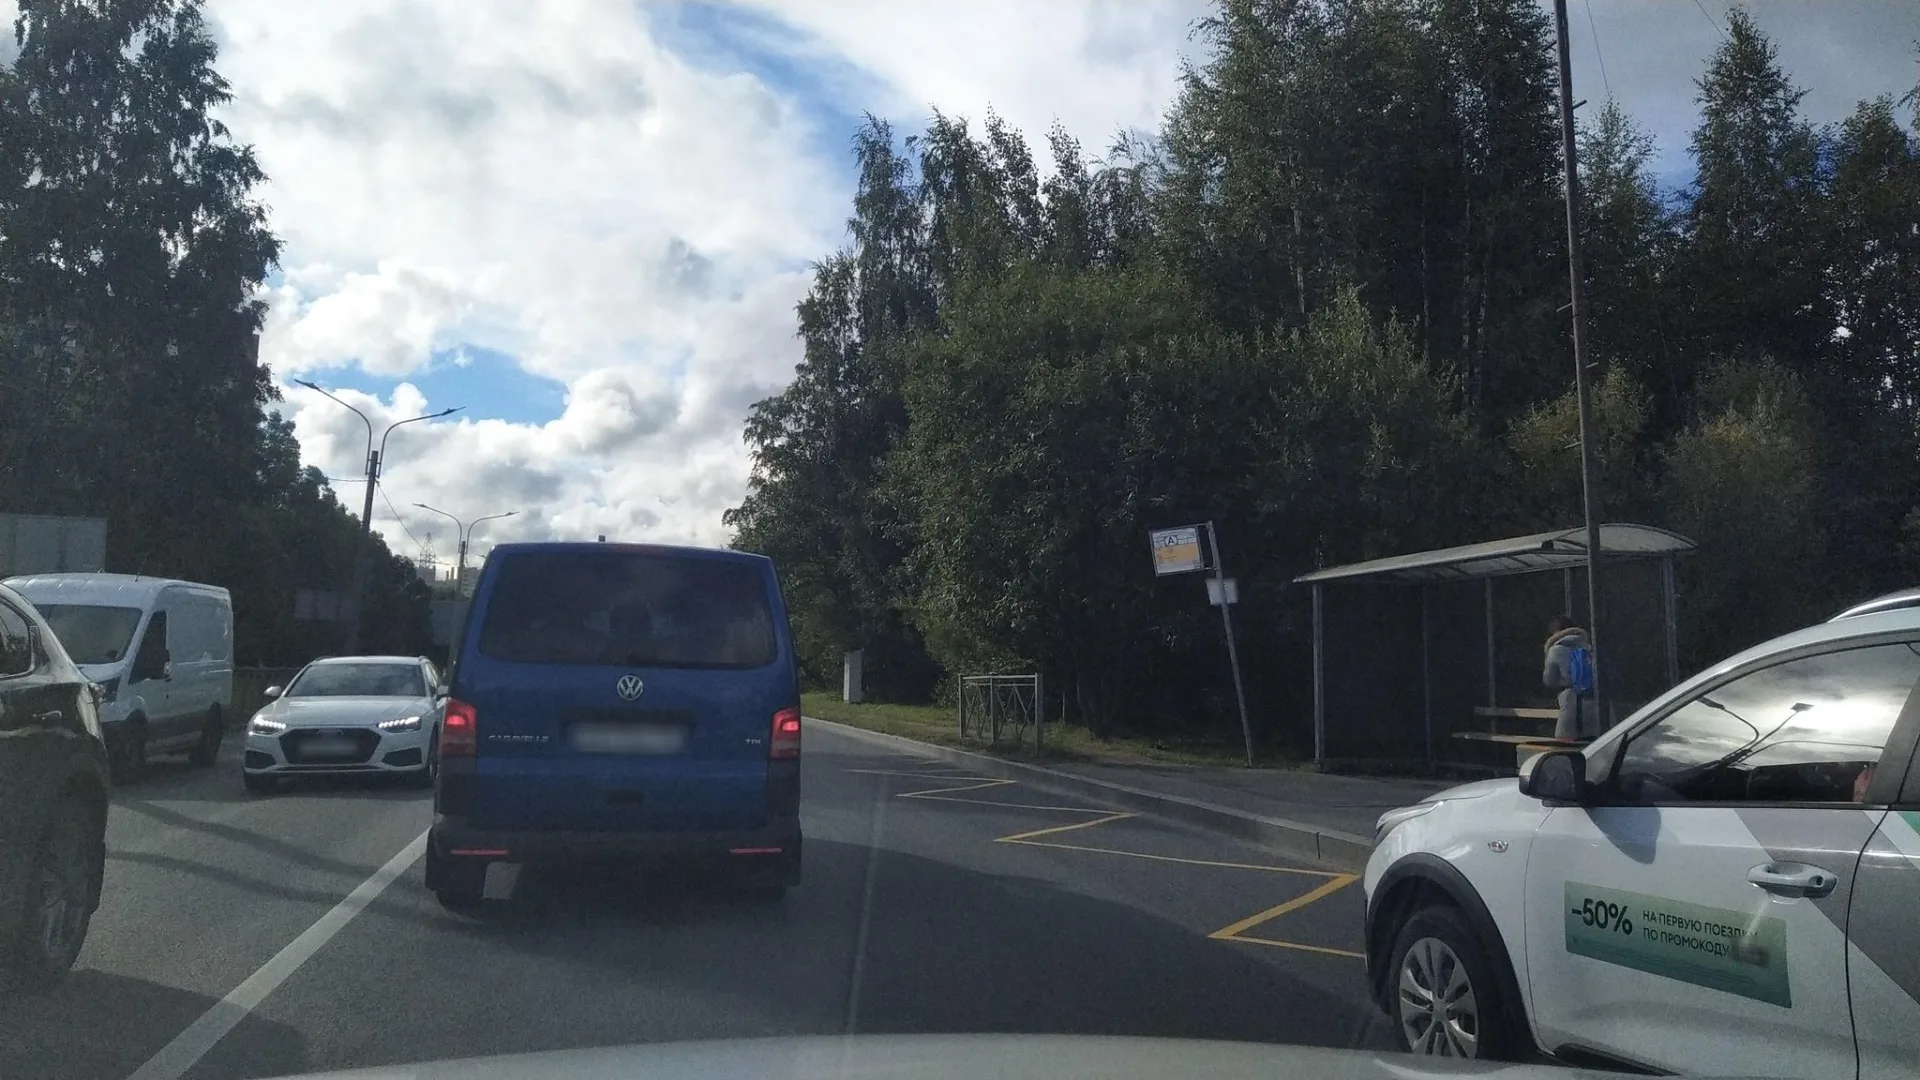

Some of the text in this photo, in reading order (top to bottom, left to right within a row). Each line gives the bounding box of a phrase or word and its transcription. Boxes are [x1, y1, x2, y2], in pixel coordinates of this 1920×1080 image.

[1571, 898, 1633, 936] -50%
[1642, 910, 1657, 923] НА
[1659, 913, 1702, 932] ПЕРВУЮ
[1643, 928, 1659, 941] ПО
[1660, 931, 1730, 957] ПРОМОКОДУ
